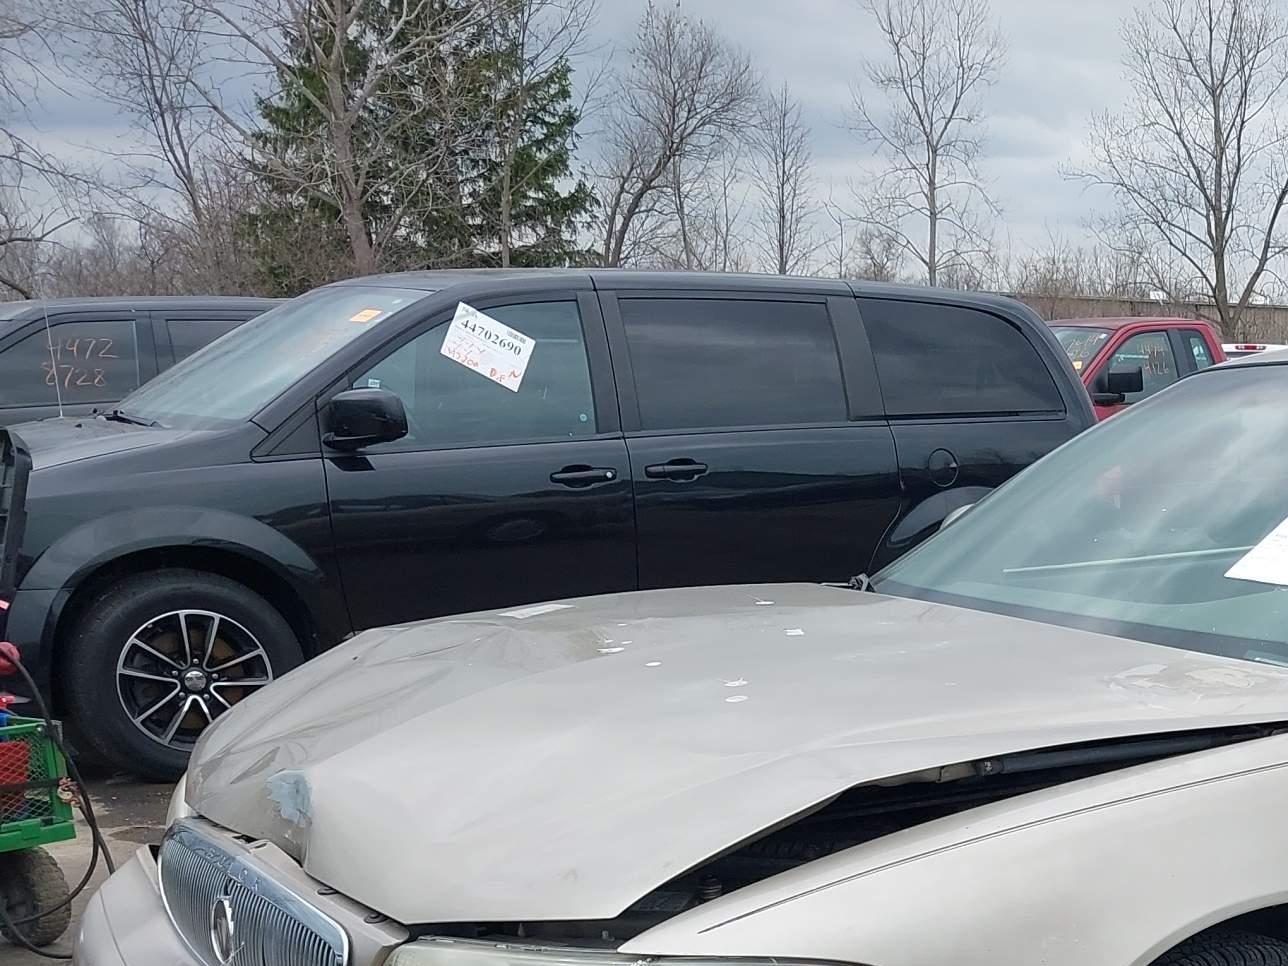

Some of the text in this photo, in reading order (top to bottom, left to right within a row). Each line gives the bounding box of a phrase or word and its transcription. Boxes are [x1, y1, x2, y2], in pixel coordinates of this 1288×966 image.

[47, 337, 120, 360] 4472
[460, 319, 522, 356] 44702690
[41, 362, 106, 390] 8728
